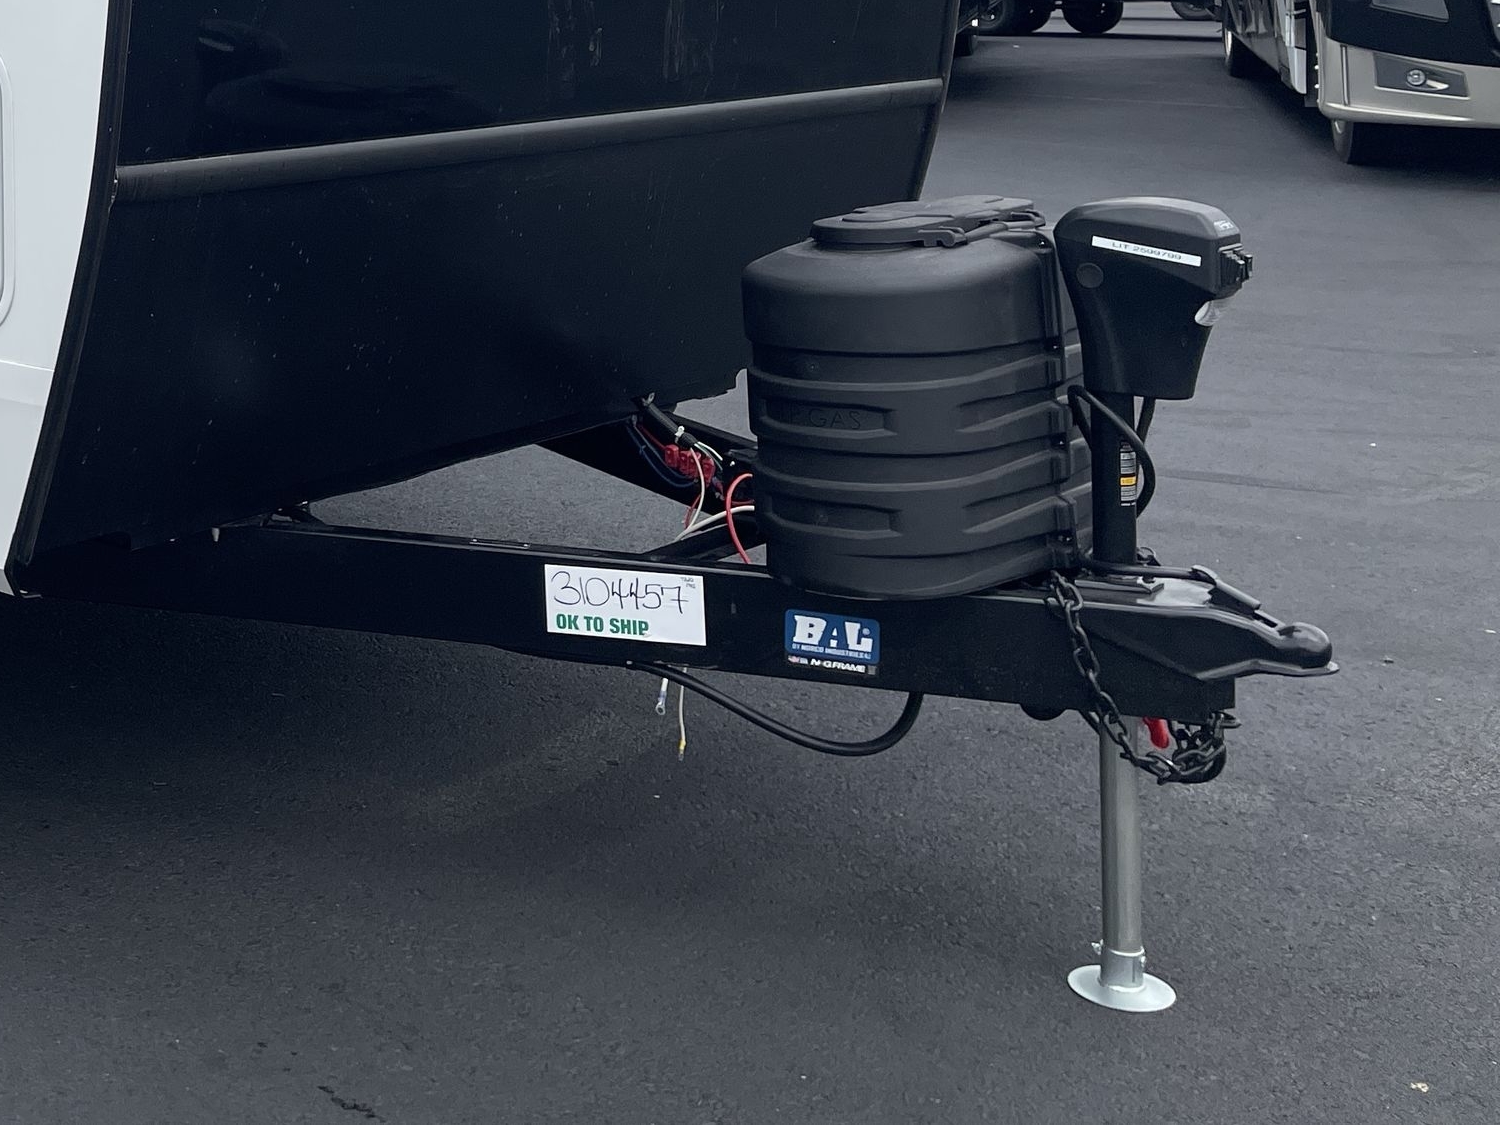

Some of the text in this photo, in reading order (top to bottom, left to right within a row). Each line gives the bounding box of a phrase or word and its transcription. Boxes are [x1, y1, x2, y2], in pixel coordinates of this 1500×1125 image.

[808, 407, 862, 431] GAS
[556, 613, 649, 636] OK TO SHIP
[793, 615, 873, 652] BAL
